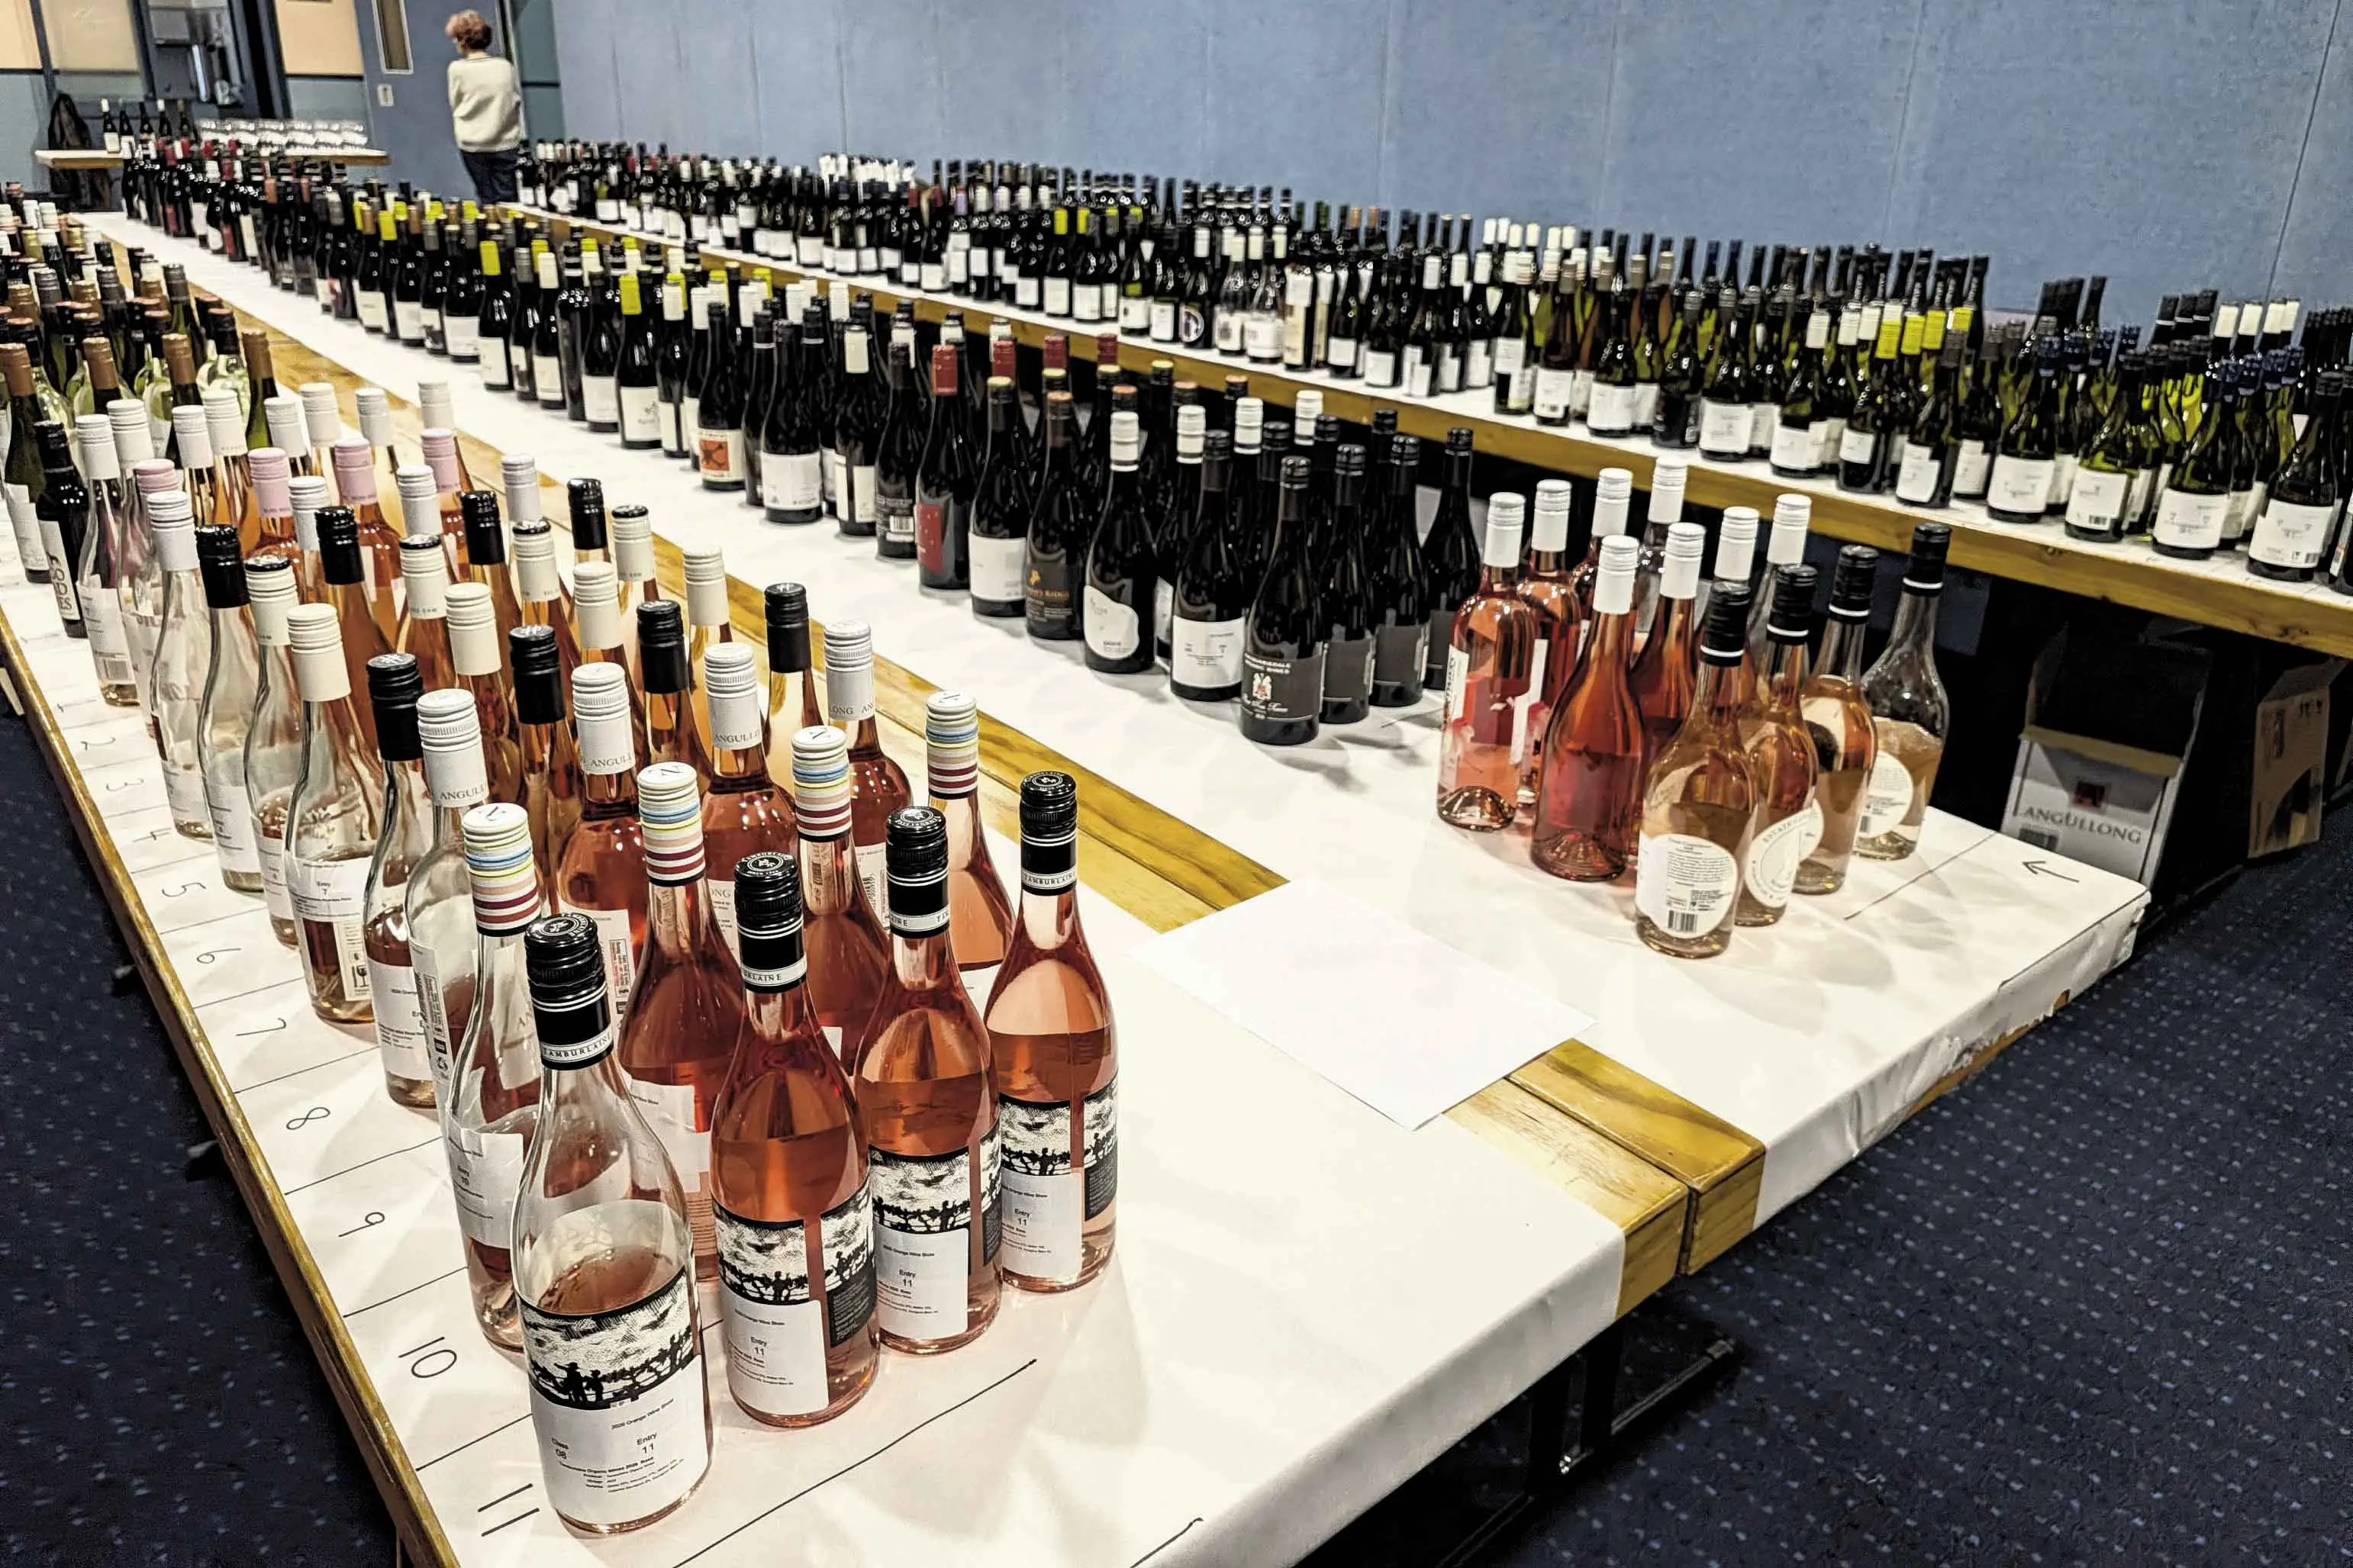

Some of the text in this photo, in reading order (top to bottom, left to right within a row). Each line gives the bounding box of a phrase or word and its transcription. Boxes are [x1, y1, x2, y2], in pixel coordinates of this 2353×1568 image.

[105, 778, 144, 792] 3
[2022, 806, 2142, 845] ANGULLONG
[133, 828, 172, 842] 4
[162, 882, 207, 898] 5
[196, 948, 242, 964] 6
[235, 1018, 287, 1037] 7
[285, 1107, 330, 1131] 8
[1014, 1208, 1030, 1217] Entry
[338, 1212, 385, 1238] 9
[1017, 1218, 1027, 1226] 11
[898, 1269, 916, 1278] Entry
[902, 1278, 913, 1288] 11
[750, 1336, 768, 1347] Entry
[398, 1336, 458, 1379] 10
[754, 1347, 765, 1356] 11
[637, 1431, 658, 1446] Entry
[641, 1442, 655, 1454] 11
[477, 1483, 540, 1537] 11
